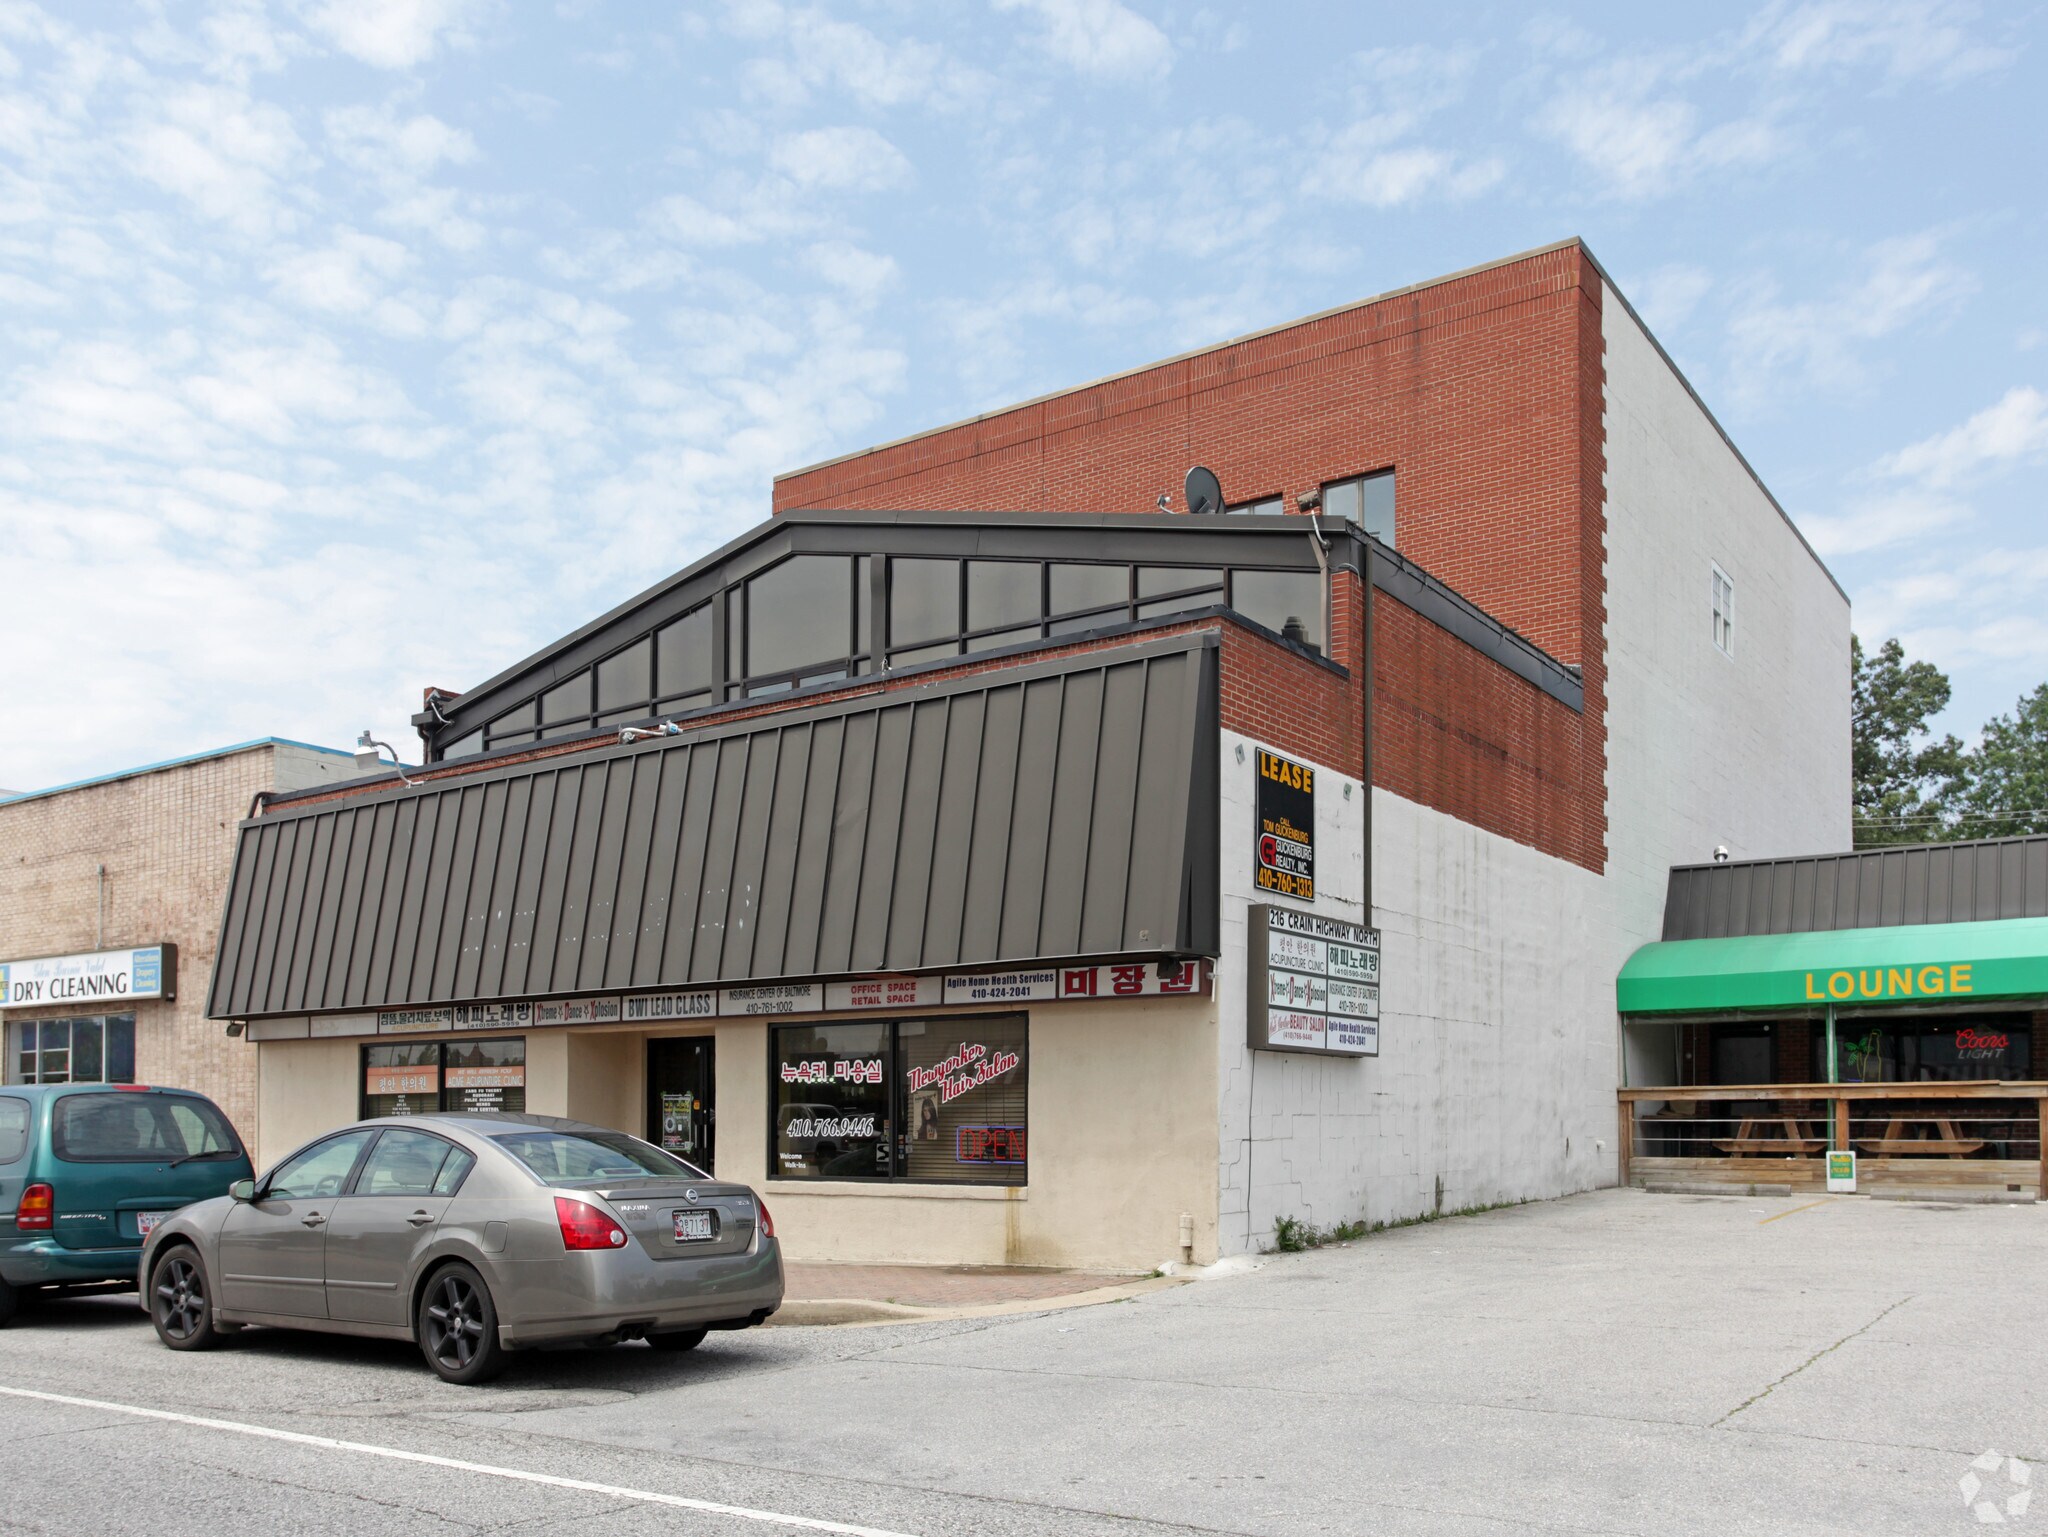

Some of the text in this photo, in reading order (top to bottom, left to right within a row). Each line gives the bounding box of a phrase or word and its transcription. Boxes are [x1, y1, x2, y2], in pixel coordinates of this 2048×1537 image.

[1261, 751, 1312, 793] LEASE
[1263, 819, 1309, 844] TOM GUCKENBURG
[1280, 817, 1291, 827] CALL
[1275, 840, 1312, 861] GUCKENBURG
[1275, 854, 1296, 872] REALTY,
[1258, 867, 1313, 898] 410-760-1313
[1270, 909, 1378, 946] 216 CRAIN HIGHWAY NORTH
[1270, 953, 1325, 972] ACUPUNCTURE CLINIC
[1329, 946, 1378, 971] 해피노래방
[14, 980, 44, 1001] DRY
[50, 972, 127, 999] CLEANING
[851, 981, 917, 994] OFFICE SPACE
[947, 972, 1054, 989] Agile Home Health Services
[1270, 972, 1325, 1007] Xtreme Dance Xplosion
[1805, 964, 1973, 1000] LOUNGE
[729, 985, 811, 1001] INSURANCE CENTER OF BALTIMORE
[851, 993, 916, 1006] RETAIL SPACE
[971, 987, 1031, 999] 410-424-2041
[1329, 983, 1346, 996] INSURANCE
[1362, 988, 1378, 1001] BALTIMORE
[456, 1003, 531, 1024] 해피노래방
[536, 1000, 618, 1023] Xtreme Dance Xplosion
[628, 993, 711, 1018] BWI LEAD CLASS
[746, 1001, 793, 1014] 410-761-1002
[1339, 1001, 1368, 1015] 410-761-1002
[391, 1022, 439, 1031] ACUPUNCTURE
[467, 1021, 520, 1029] (410)590-5959
[1289, 1014, 1308, 1031] BEAUTY
[1309, 1015, 1325, 1033] SALON
[1339, 1022, 1349, 1032] Home
[1349, 1023, 1360, 1034] Health
[1361, 1024, 1376, 1036] Services
[1955, 1028, 2010, 1049] Coors
[1958, 1048, 2005, 1059] LIGHT
[781, 1059, 883, 1084] 뉴욕커 미용실
[907, 1041, 986, 1093] Newyorker
[503, 1074, 523, 1086] CLINIC
[938, 1052, 1019, 1104] Hair Salon
[786, 1117, 875, 1137] 410.766.9446
[959, 1129, 1025, 1161] OPEN
[780, 1152, 802, 1160] Welcome
[784, 1161, 806, 1169] Walk-Ins
